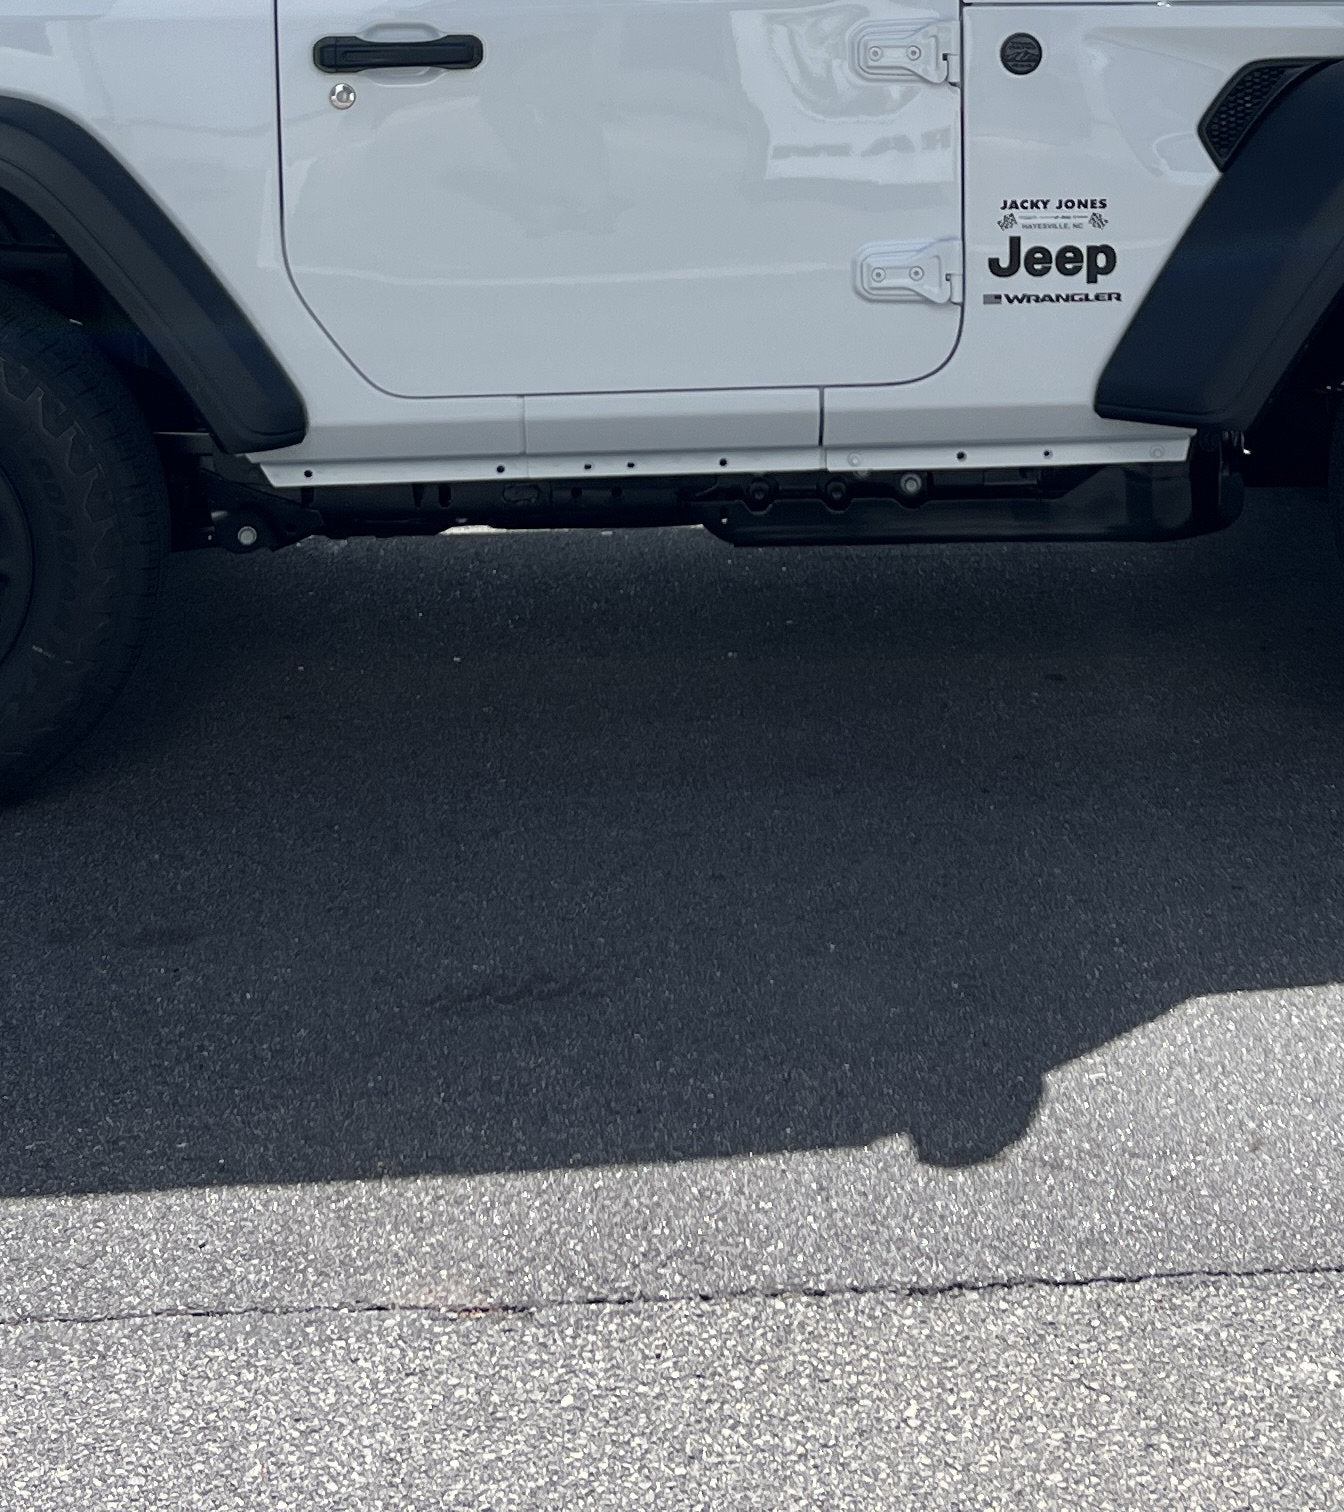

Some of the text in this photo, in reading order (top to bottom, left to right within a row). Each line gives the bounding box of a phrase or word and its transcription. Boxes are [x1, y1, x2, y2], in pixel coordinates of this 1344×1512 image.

[1000, 198, 1108, 210] JACKY JONES
[988, 236, 1117, 284] Jeep
[1004, 292, 1122, 304] WRANGLER
